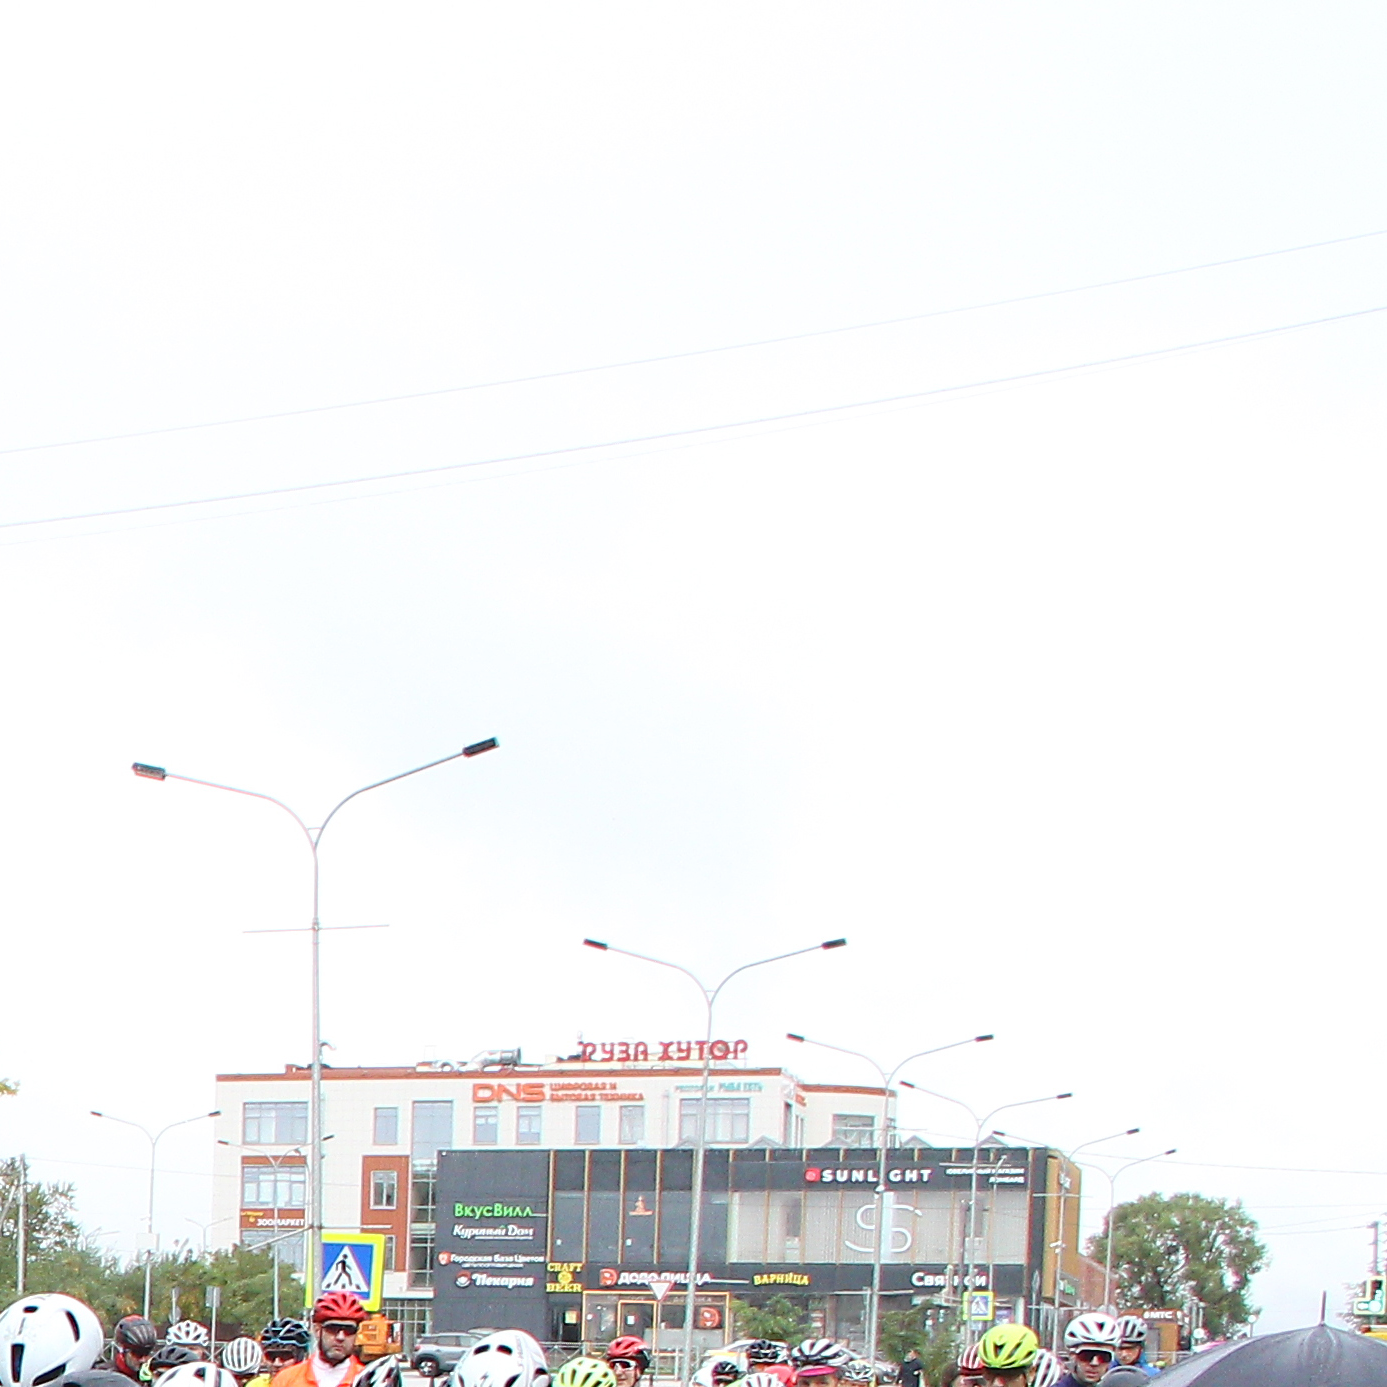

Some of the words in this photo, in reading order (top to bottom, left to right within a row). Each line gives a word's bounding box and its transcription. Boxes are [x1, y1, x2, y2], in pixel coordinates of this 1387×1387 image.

[657, 1039, 748, 1061] ХУТОР
[473, 1083, 546, 1103] DNS
[822, 1169, 932, 1183] SUNLGHT
[454, 1203, 533, 1220] ВкусВилл
[508, 1224, 534, 1236] Дом
[547, 1262, 583, 1273] CRAFT
[471, 1273, 535, 1289] Пекарня
[546, 1283, 583, 1293] BEER
